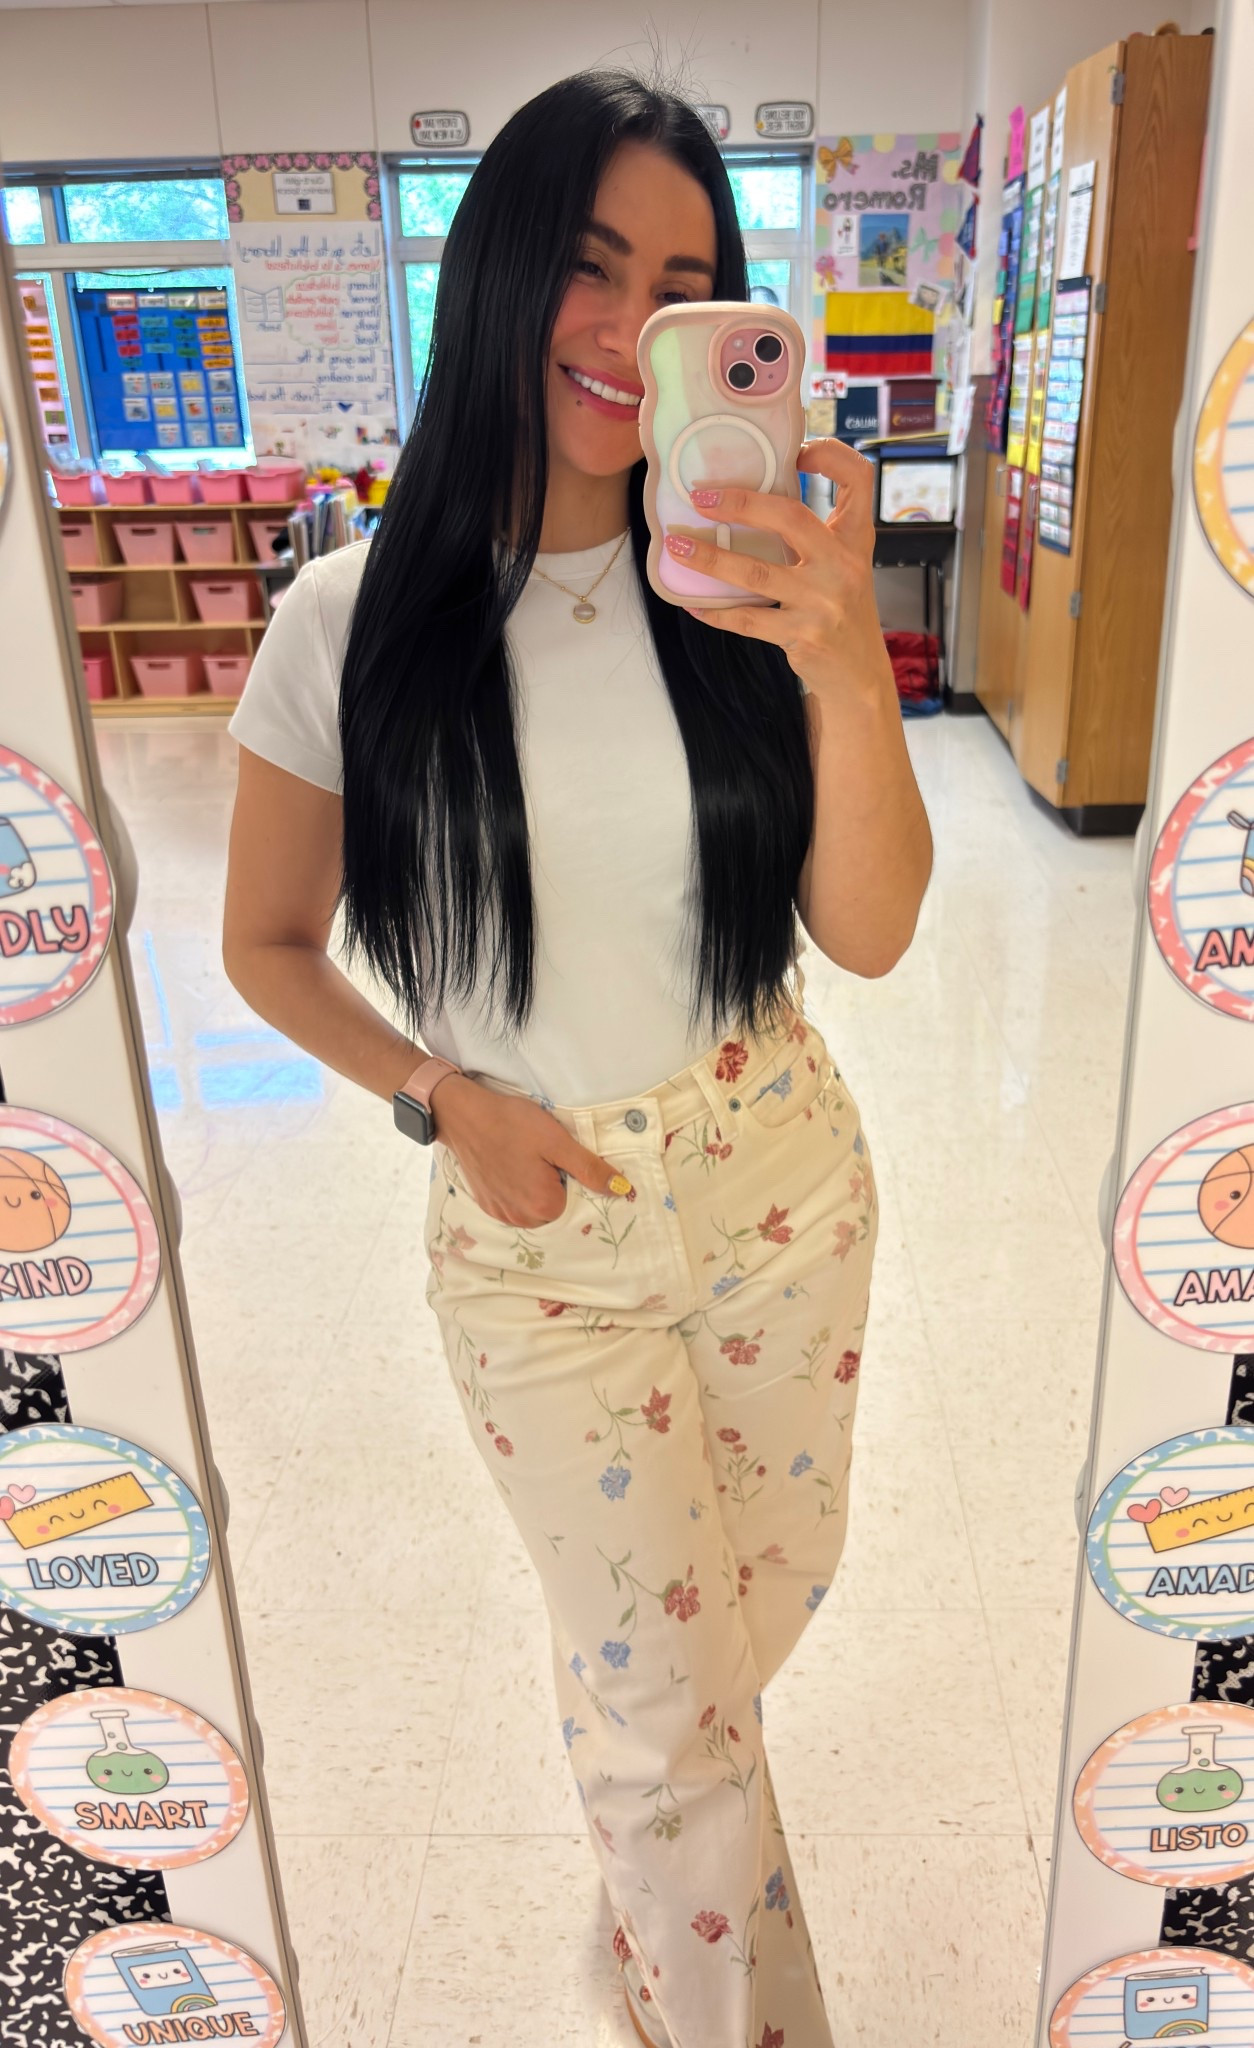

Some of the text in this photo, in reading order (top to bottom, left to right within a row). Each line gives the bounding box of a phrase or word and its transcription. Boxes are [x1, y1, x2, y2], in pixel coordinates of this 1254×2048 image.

[0, 904, 91, 958] DLY
[26, 1552, 159, 1590] LOVED
[75, 1800, 208, 1830] SMART
[1150, 1823, 1248, 1852] LISTO
[122, 2011, 260, 2046] UNIQUE
